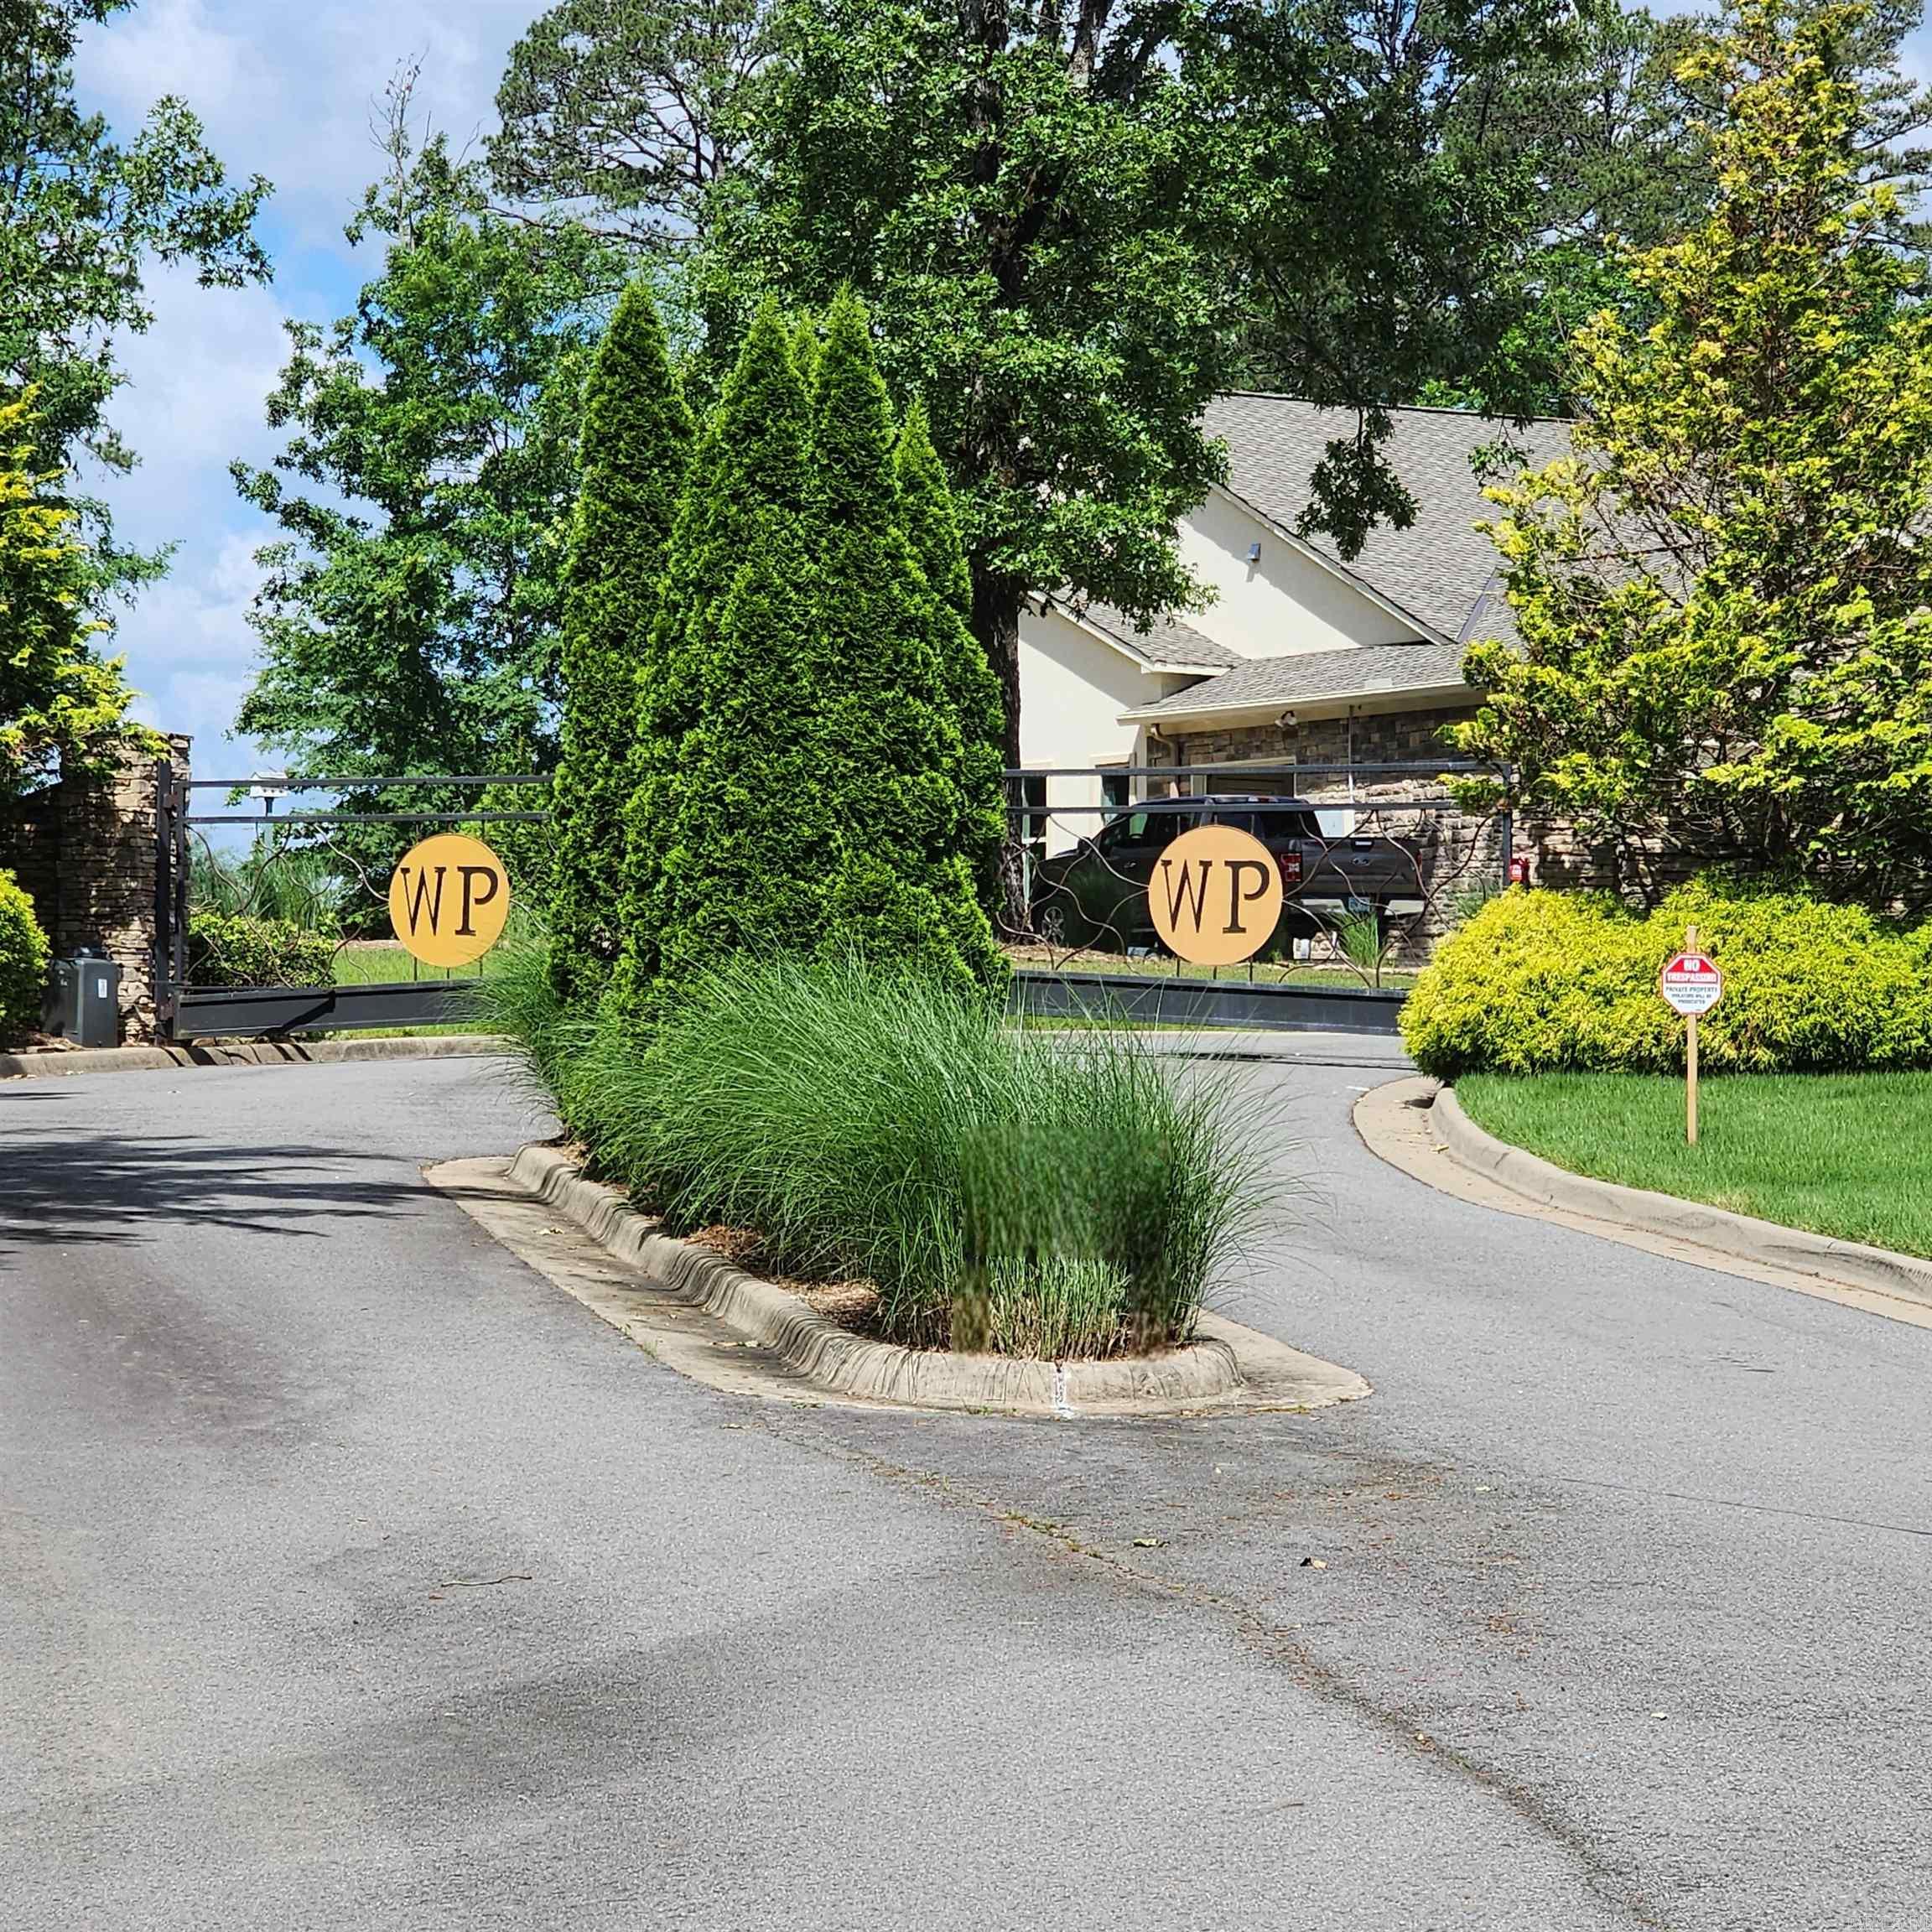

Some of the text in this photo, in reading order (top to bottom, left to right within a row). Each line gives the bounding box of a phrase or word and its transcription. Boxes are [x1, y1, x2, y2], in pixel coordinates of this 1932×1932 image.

[400, 865, 499, 937] WP
[1161, 859, 1270, 934] WP
[1683, 958, 1701, 971] NO
